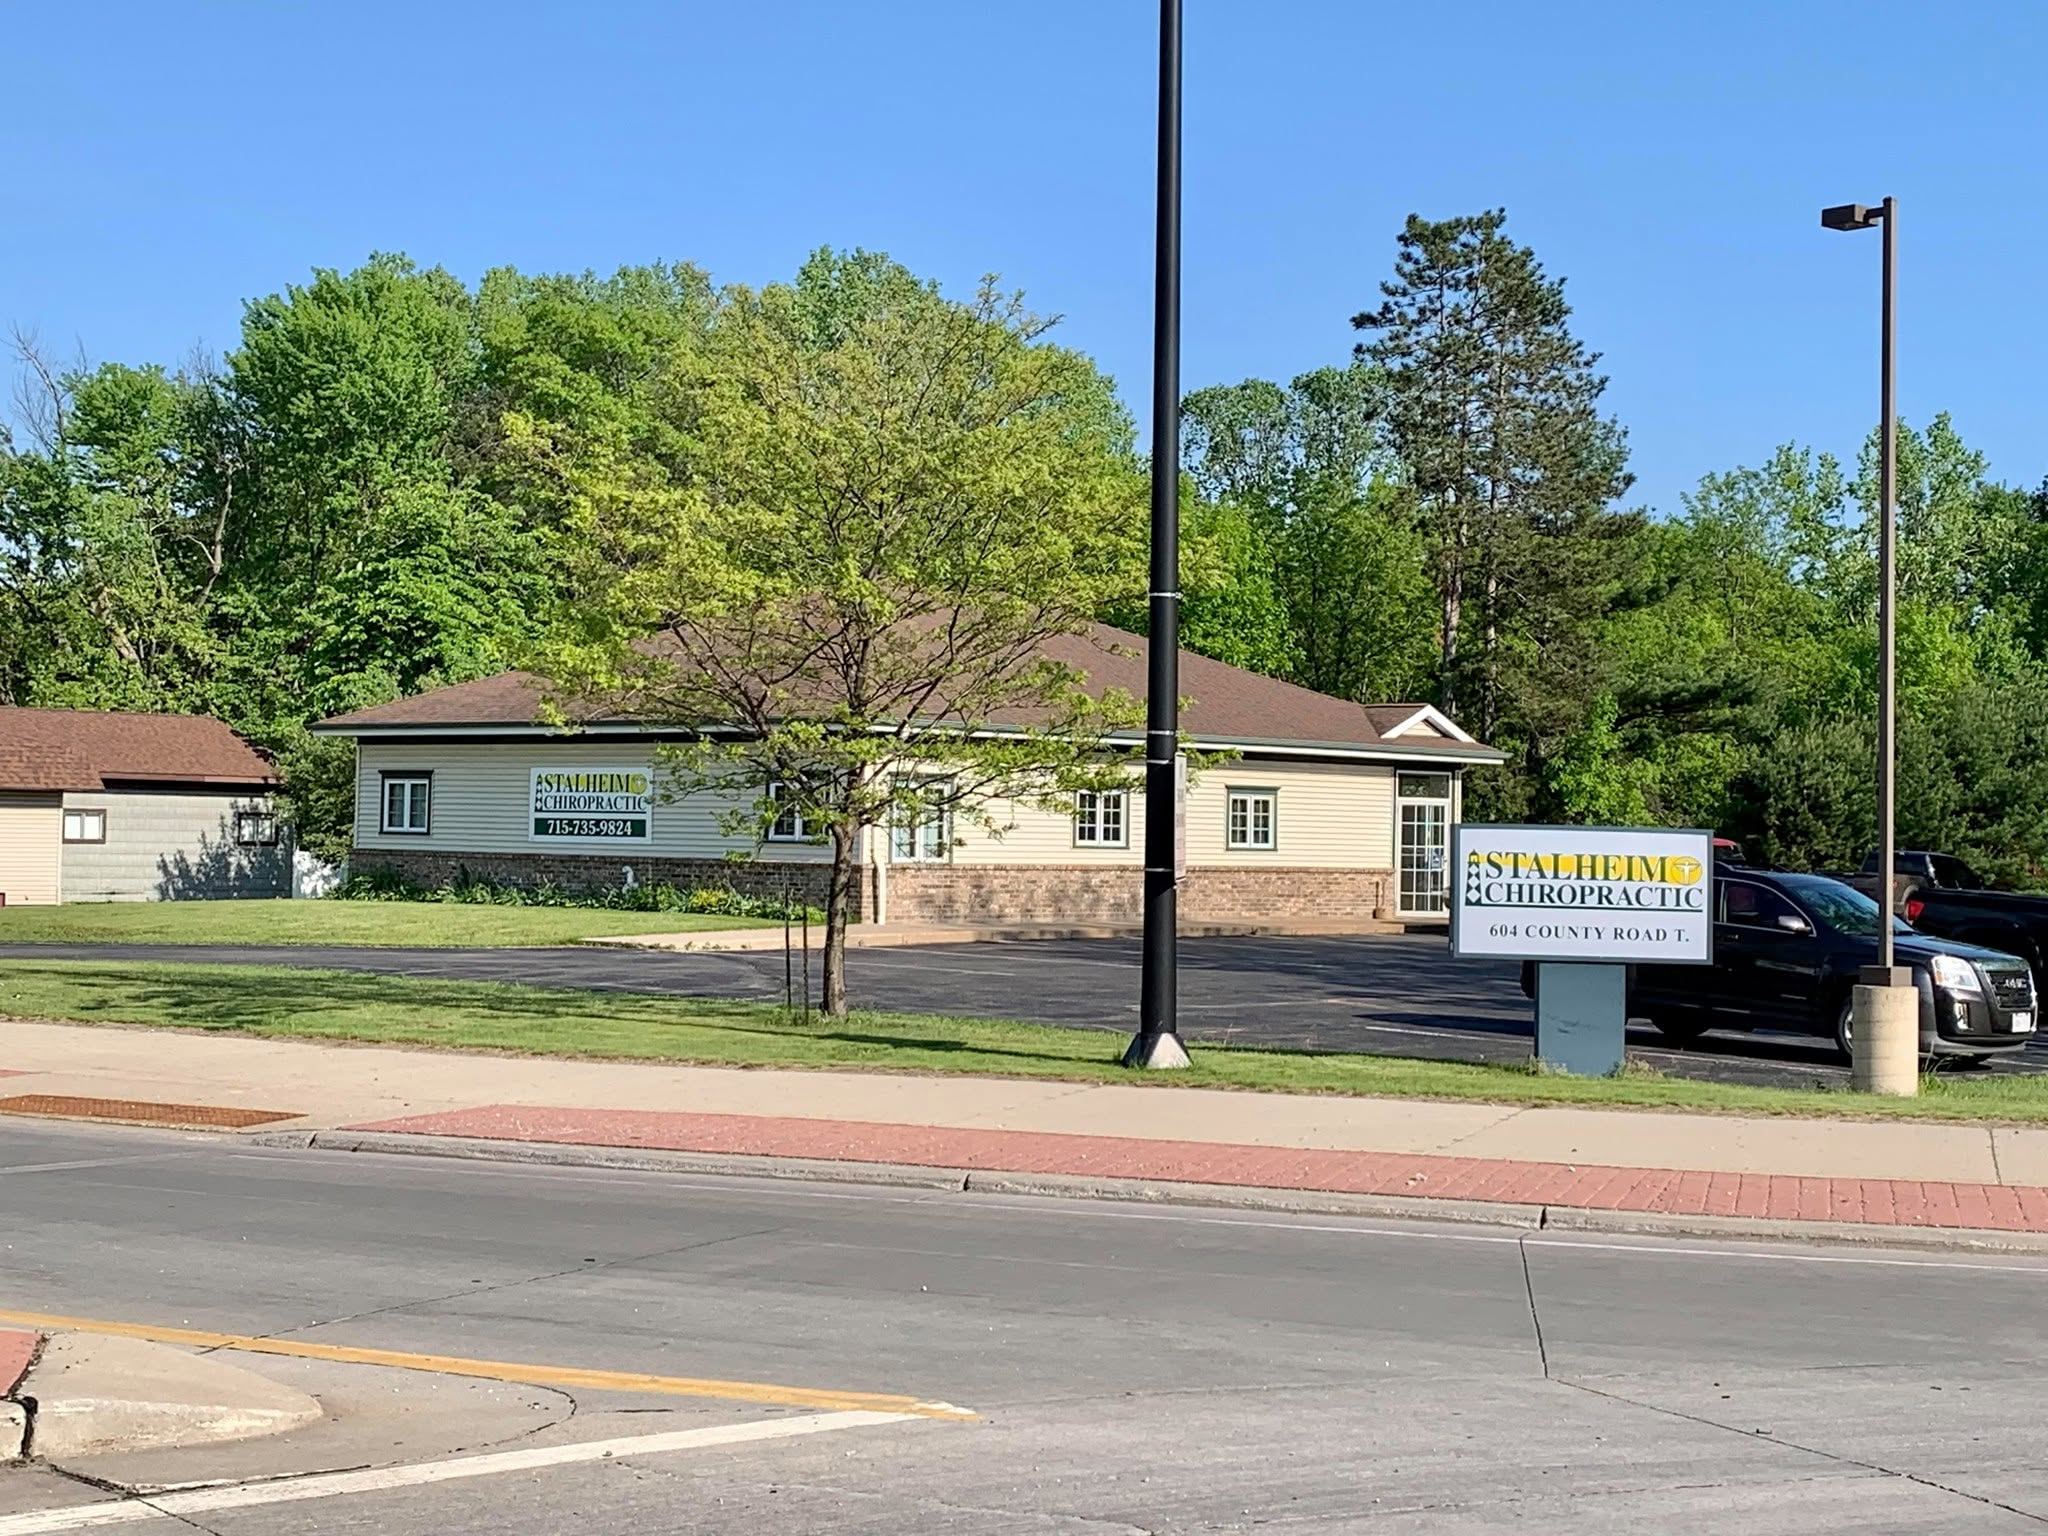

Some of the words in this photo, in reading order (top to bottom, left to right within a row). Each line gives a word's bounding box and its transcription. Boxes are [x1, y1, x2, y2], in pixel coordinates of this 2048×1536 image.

[544, 774, 630, 793] STALHEIM
[544, 795, 647, 811] CHIROPRACTIC
[547, 820, 632, 835] 715-735-9824
[1485, 850, 1669, 883] STALHEIM
[1484, 882, 1703, 909] CHIROPRACTIC
[1489, 923, 1518, 938] 604
[1525, 924, 1606, 941] COUNTY
[1613, 927, 1667, 942] ROAD
[1674, 928, 1690, 943] T.
